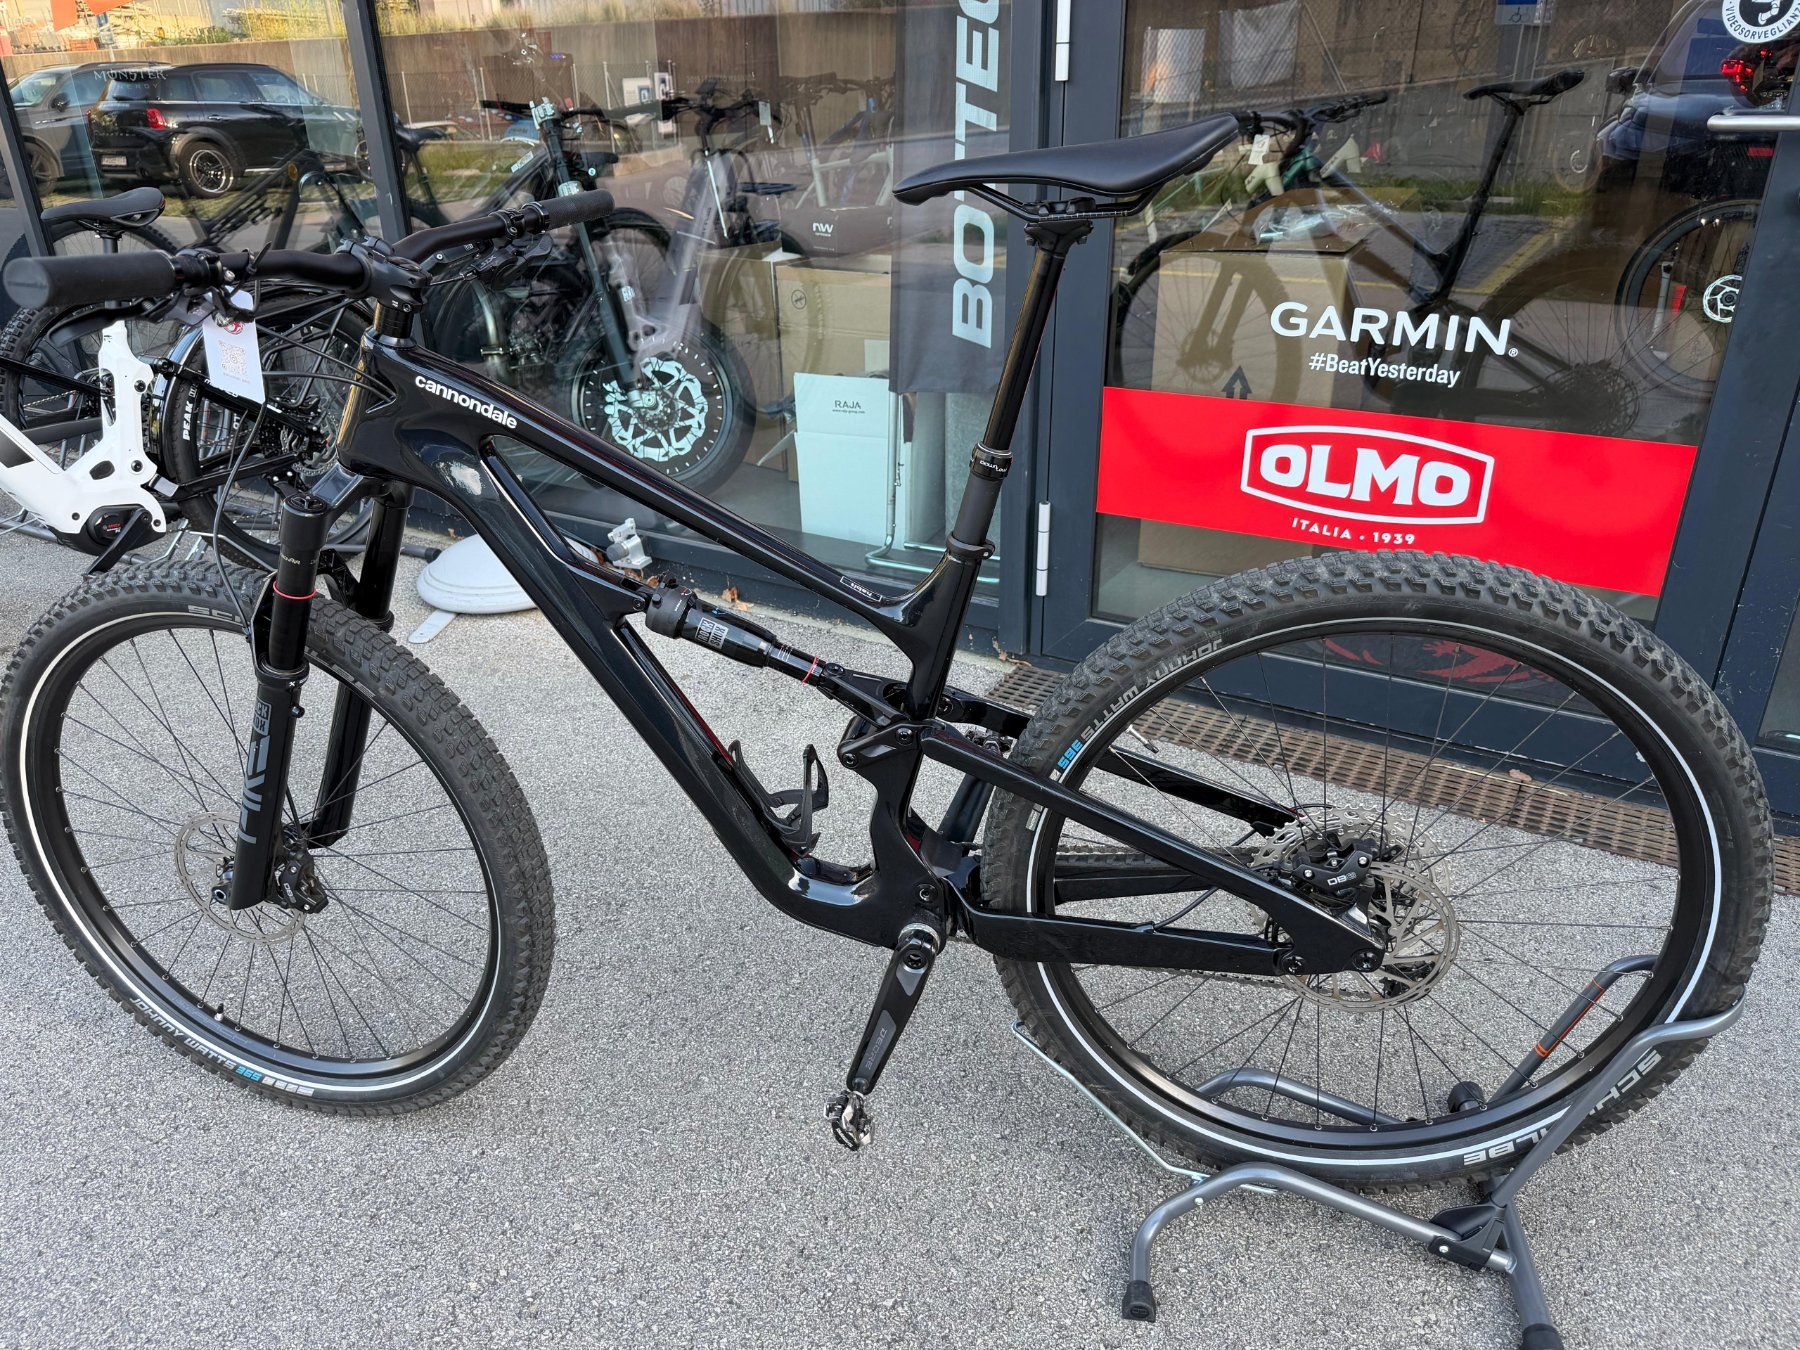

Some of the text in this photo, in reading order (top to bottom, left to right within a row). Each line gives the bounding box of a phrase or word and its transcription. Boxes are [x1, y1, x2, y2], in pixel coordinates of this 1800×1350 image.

[1725, 3, 1800, 40] VIDEOSORVEGLIANZ
[952, 0, 1000, 349] BOTE
[1270, 301, 1512, 356] GARMIN
[1308, 352, 1461, 388] #BeatYesterday
[182, 400, 195, 441] PEAK
[415, 375, 518, 429] cannondale
[834, 399, 862, 410] RAJA
[1259, 444, 1471, 507] OLMO
[1291, 517, 1416, 545] ITALIA 1939
[1057, 638, 1223, 770] JOHNNY WATTS 365
[129, 997, 185, 1038] JOHNNY
[183, 1036, 238, 1070] WATTS
[235, 1065, 263, 1083] 365
